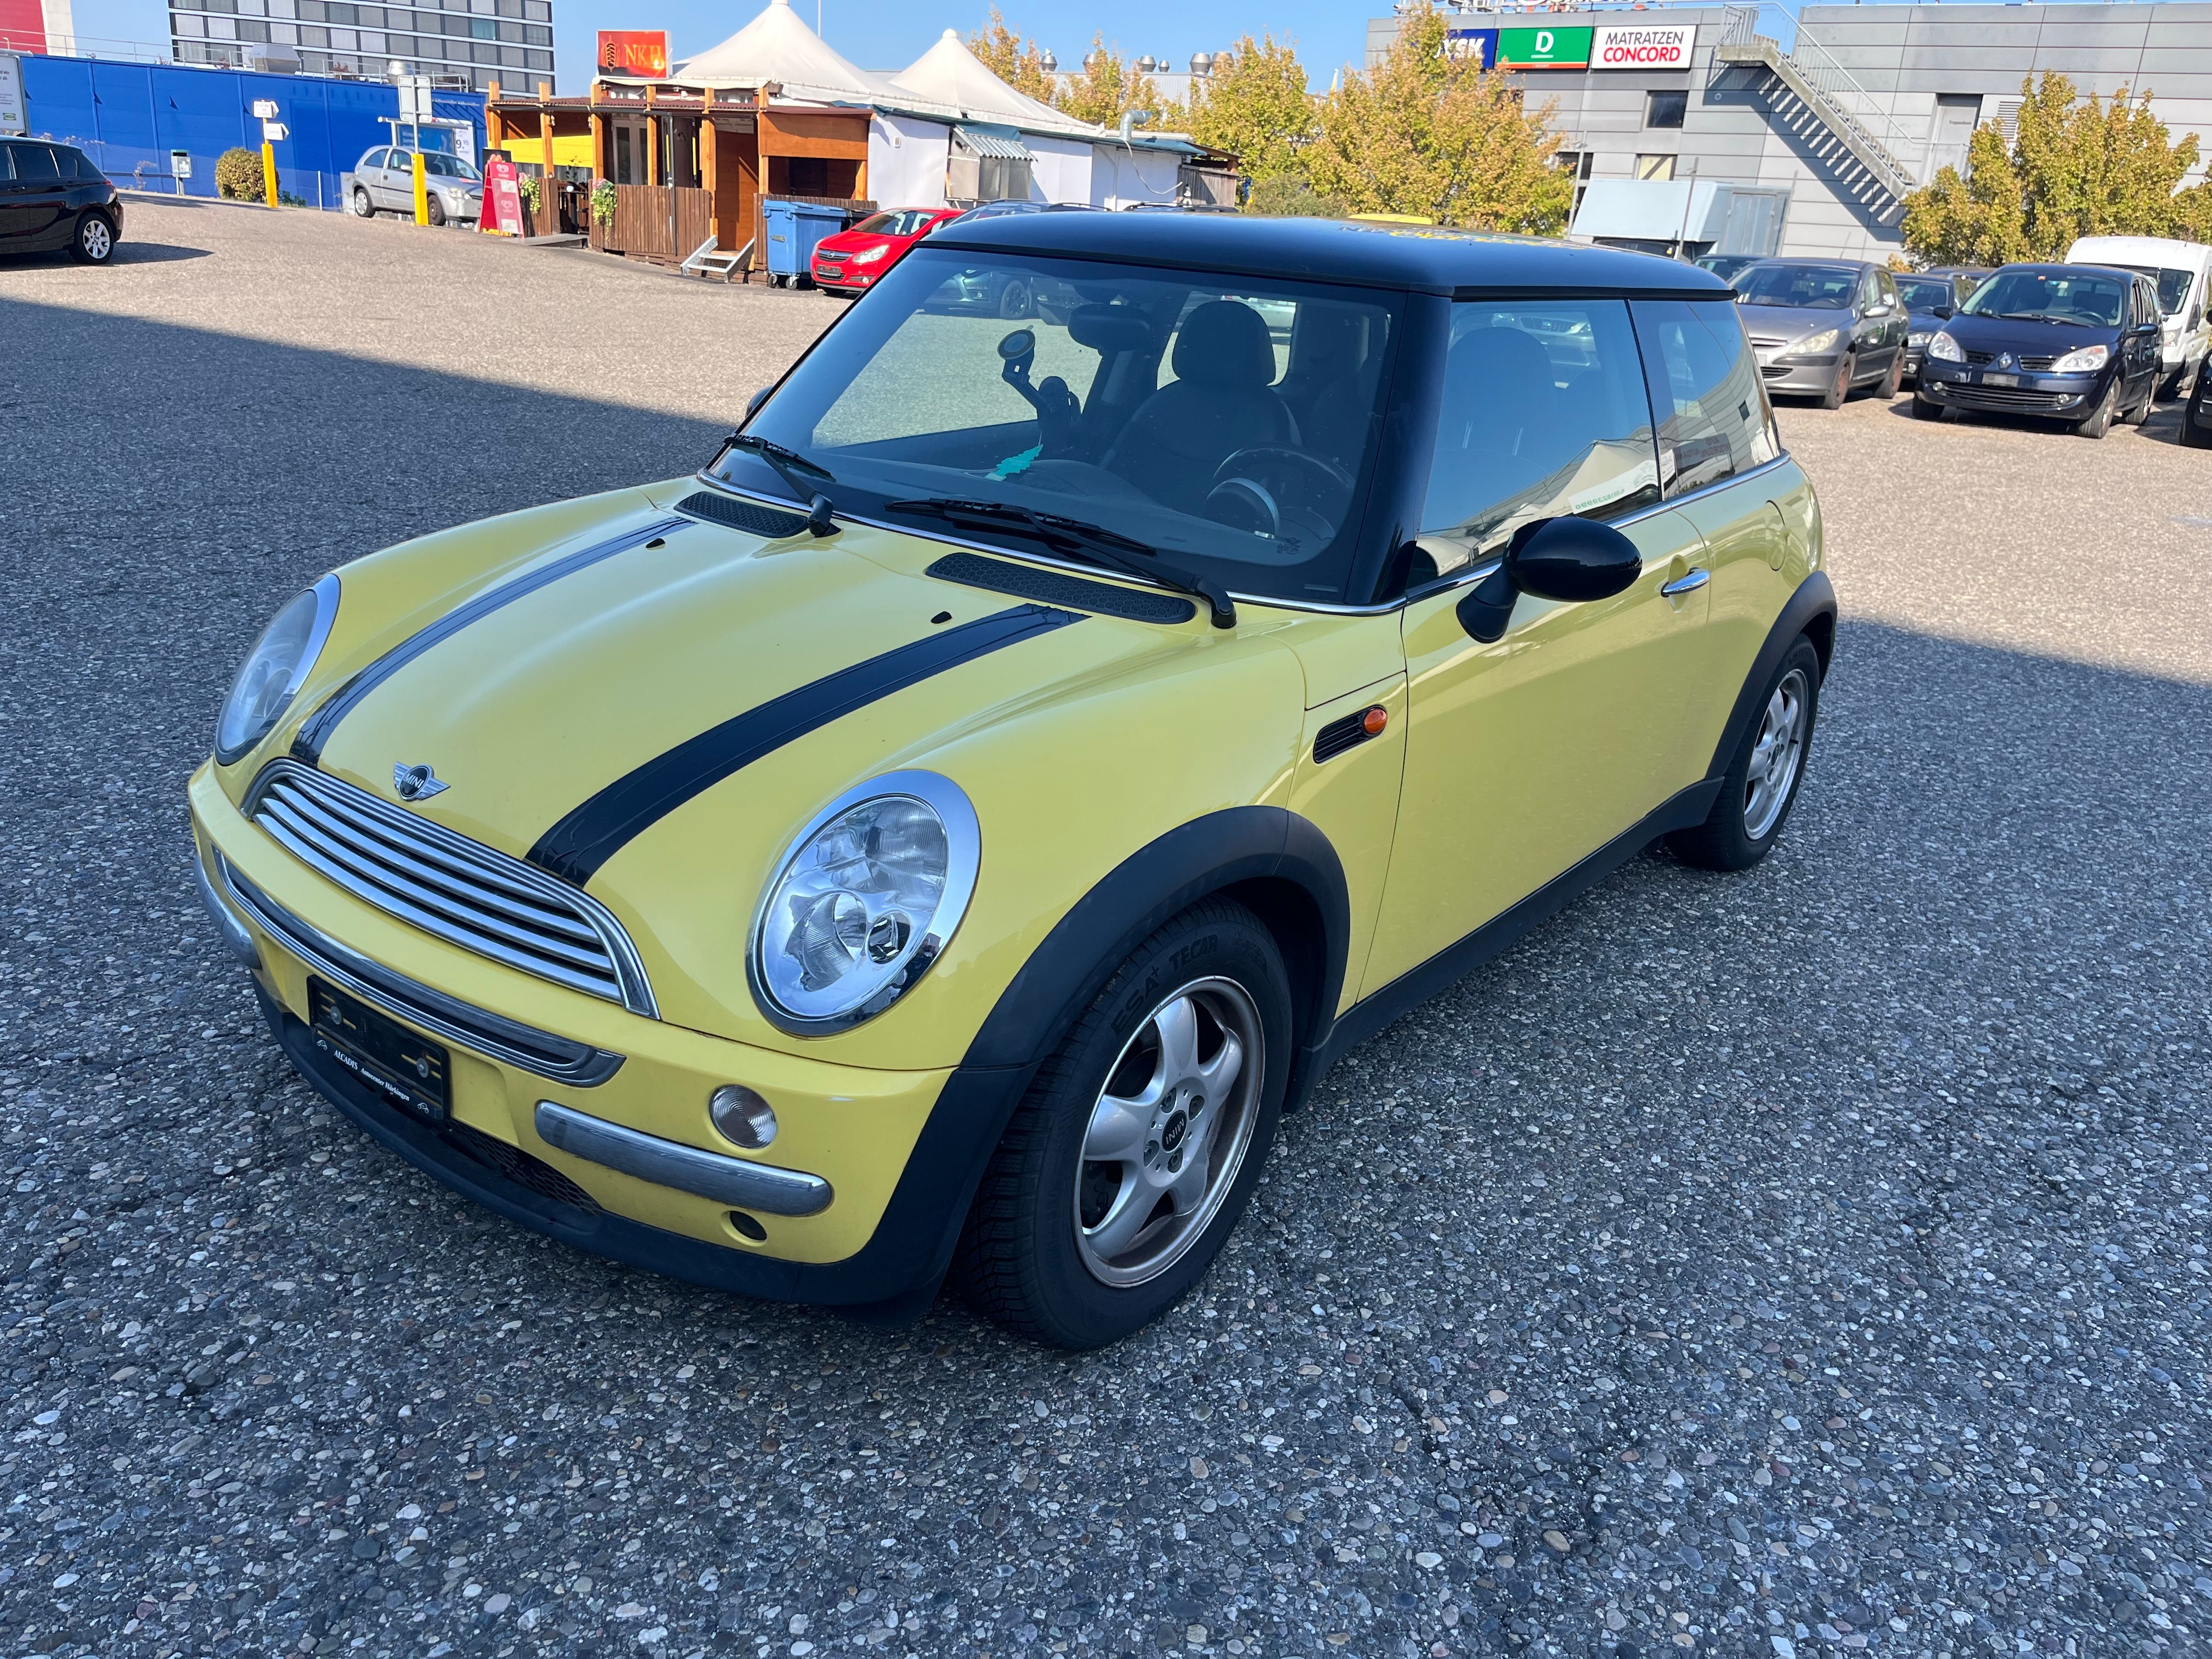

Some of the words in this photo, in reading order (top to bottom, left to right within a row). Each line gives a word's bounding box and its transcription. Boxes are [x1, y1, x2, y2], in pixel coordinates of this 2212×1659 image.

[1535, 31, 1554, 53] D
[1605, 31, 1684, 45] MATRATZEN
[624, 44, 664, 66] NKH
[1603, 47, 1680, 63] CONCORD
[405, 773, 425, 789] MINI
[1168, 934, 1218, 972] TECAR
[334, 1049, 358, 1070] ALCADIS
[360, 1068, 385, 1086] Autocenter
[1165, 1118, 1184, 1145] MINI
